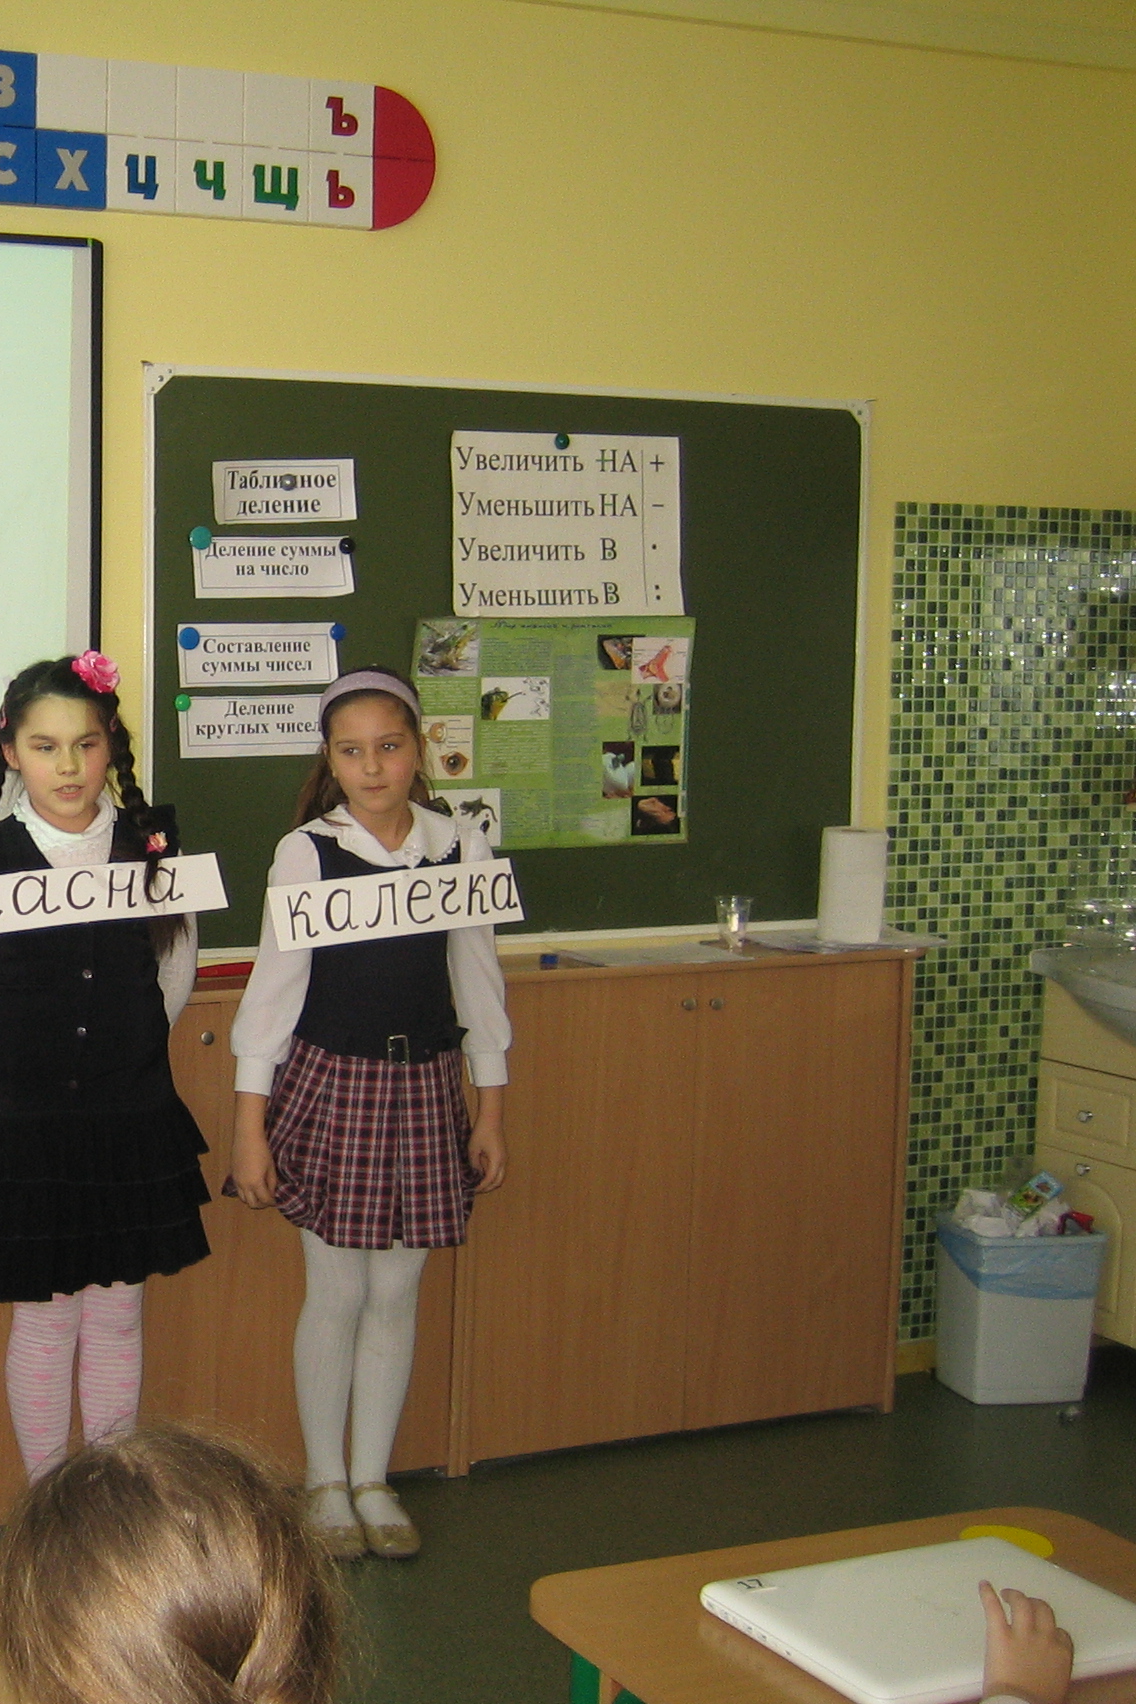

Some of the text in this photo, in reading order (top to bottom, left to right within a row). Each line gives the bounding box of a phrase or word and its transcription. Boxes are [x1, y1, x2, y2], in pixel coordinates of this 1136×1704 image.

[325, 96, 358, 136] Ъ
[54, 148, 90, 192] Х
[125, 153, 159, 200] Ц
[193, 159, 226, 201] Ч
[252, 164, 300, 212] Щ
[326, 169, 356, 209] Ь
[455, 446, 584, 473] Увеличить
[599, 449, 638, 473] НА
[227, 470, 337, 491] Таблиное
[237, 498, 321, 516] деление
[457, 491, 595, 517] Уменьшить
[599, 493, 638, 517] НА
[205, 541, 336, 561] Деление суммы
[458, 537, 585, 562] Увеличить
[600, 537, 618, 561] В
[235, 563, 309, 576] на число
[459, 582, 599, 608] Уменьшить
[602, 581, 620, 605] В
[202, 637, 311, 655] Составление
[201, 659, 312, 677] суммы чисел
[224, 700, 295, 718] Деление
[195, 722, 270, 739] круглых
[287, 871, 518, 941] калечка
